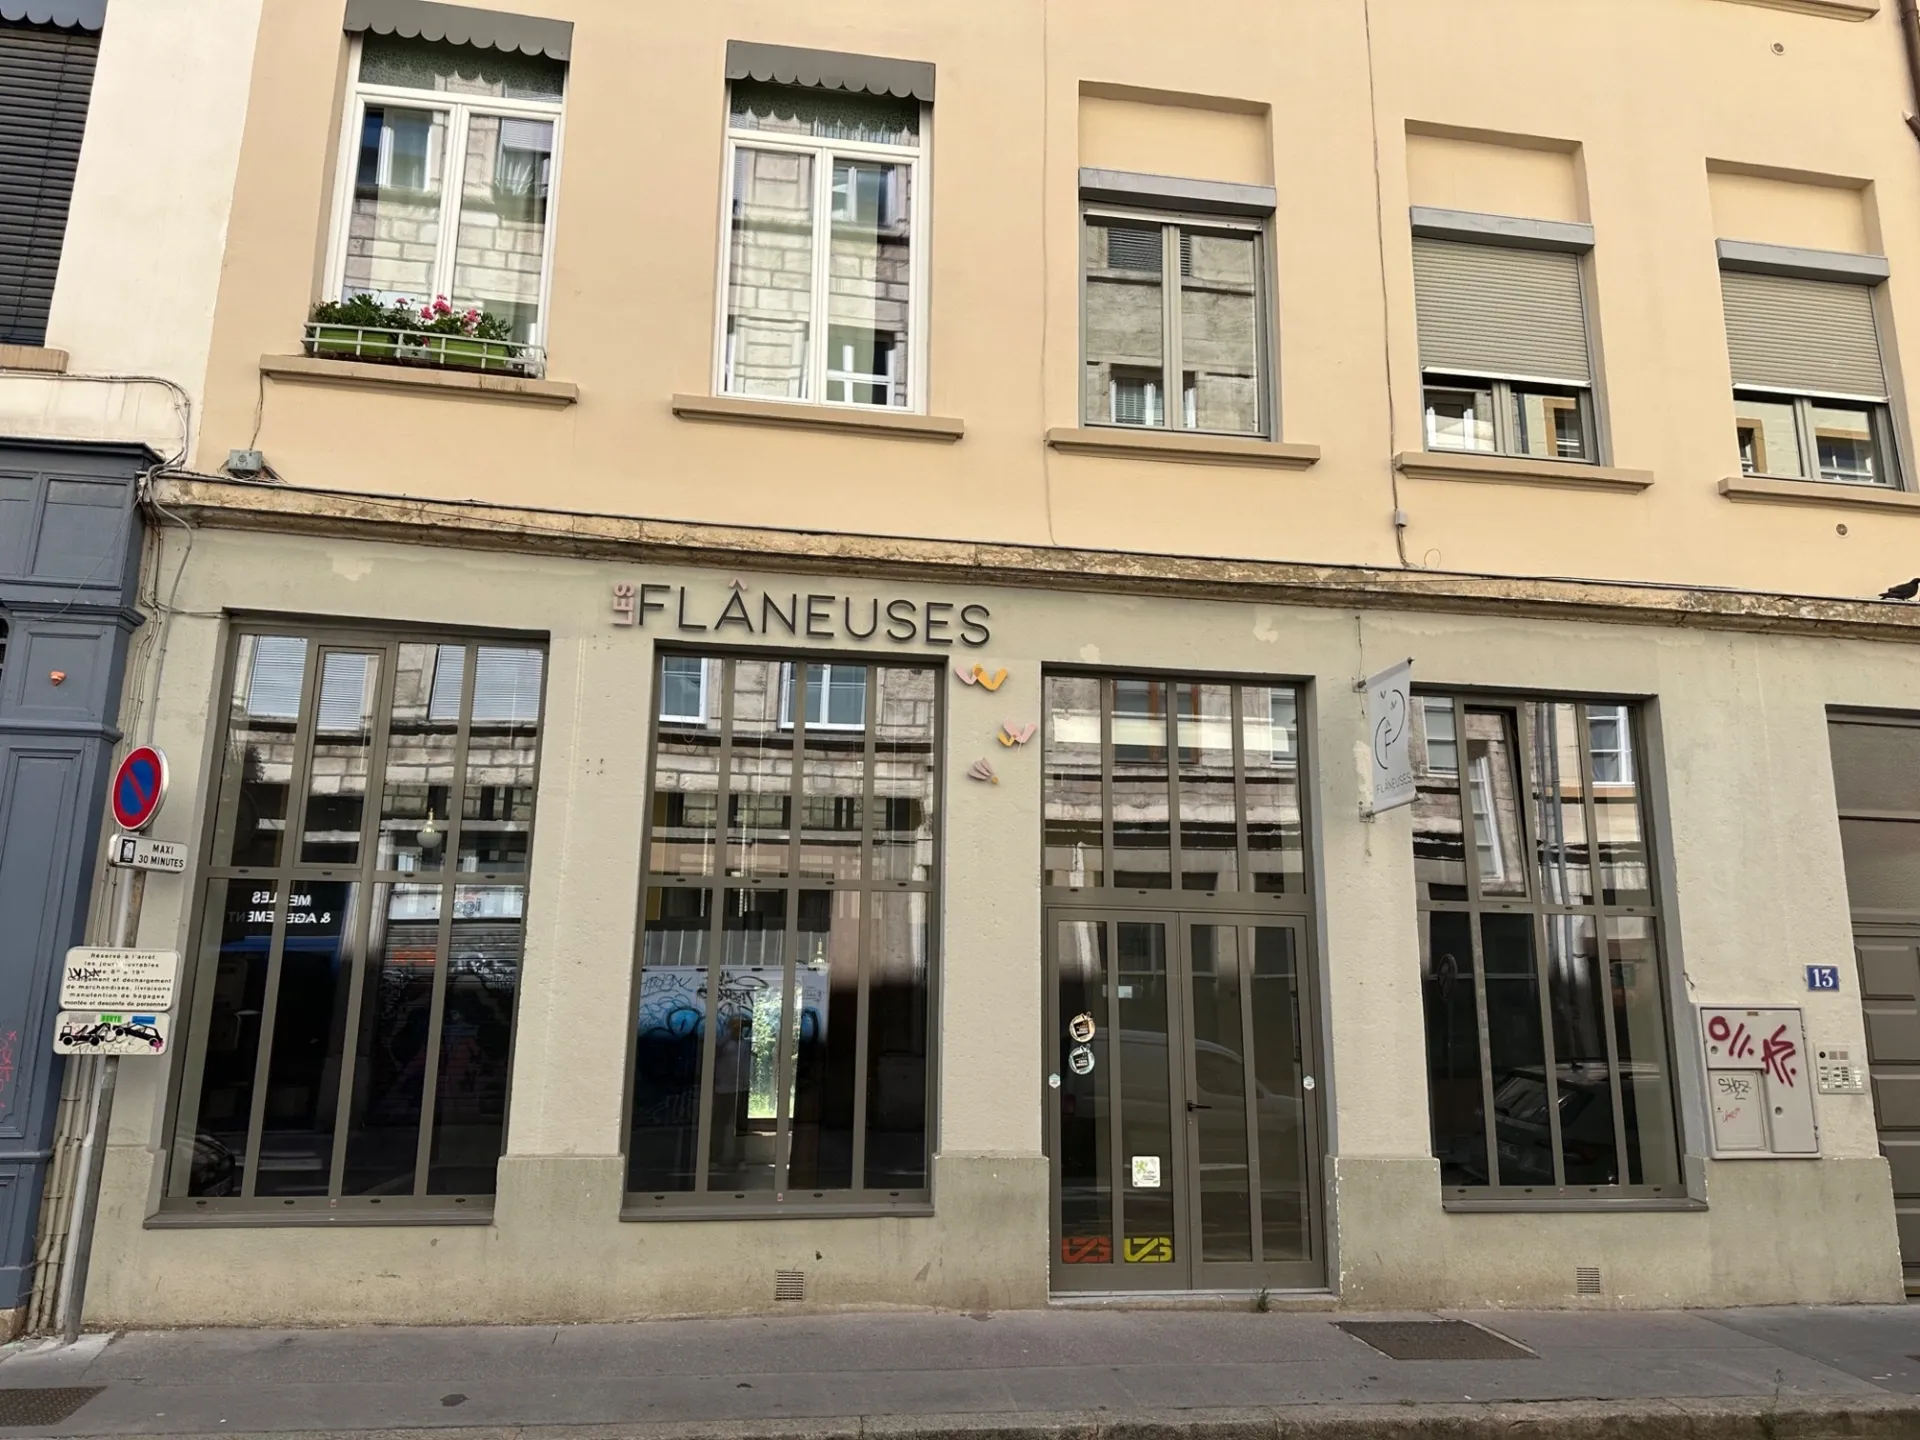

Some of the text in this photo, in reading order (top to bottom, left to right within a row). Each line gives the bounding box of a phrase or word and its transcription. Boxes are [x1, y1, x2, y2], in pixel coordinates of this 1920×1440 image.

[612, 580, 635, 626] LES
[638, 578, 991, 646] FLÂNEUSES
[1376, 772, 1413, 794] FLÂNEUSES
[153, 843, 174, 855] MAXI
[138, 854, 184, 868] 30 MINUTES
[1812, 968, 1834, 988] 13
